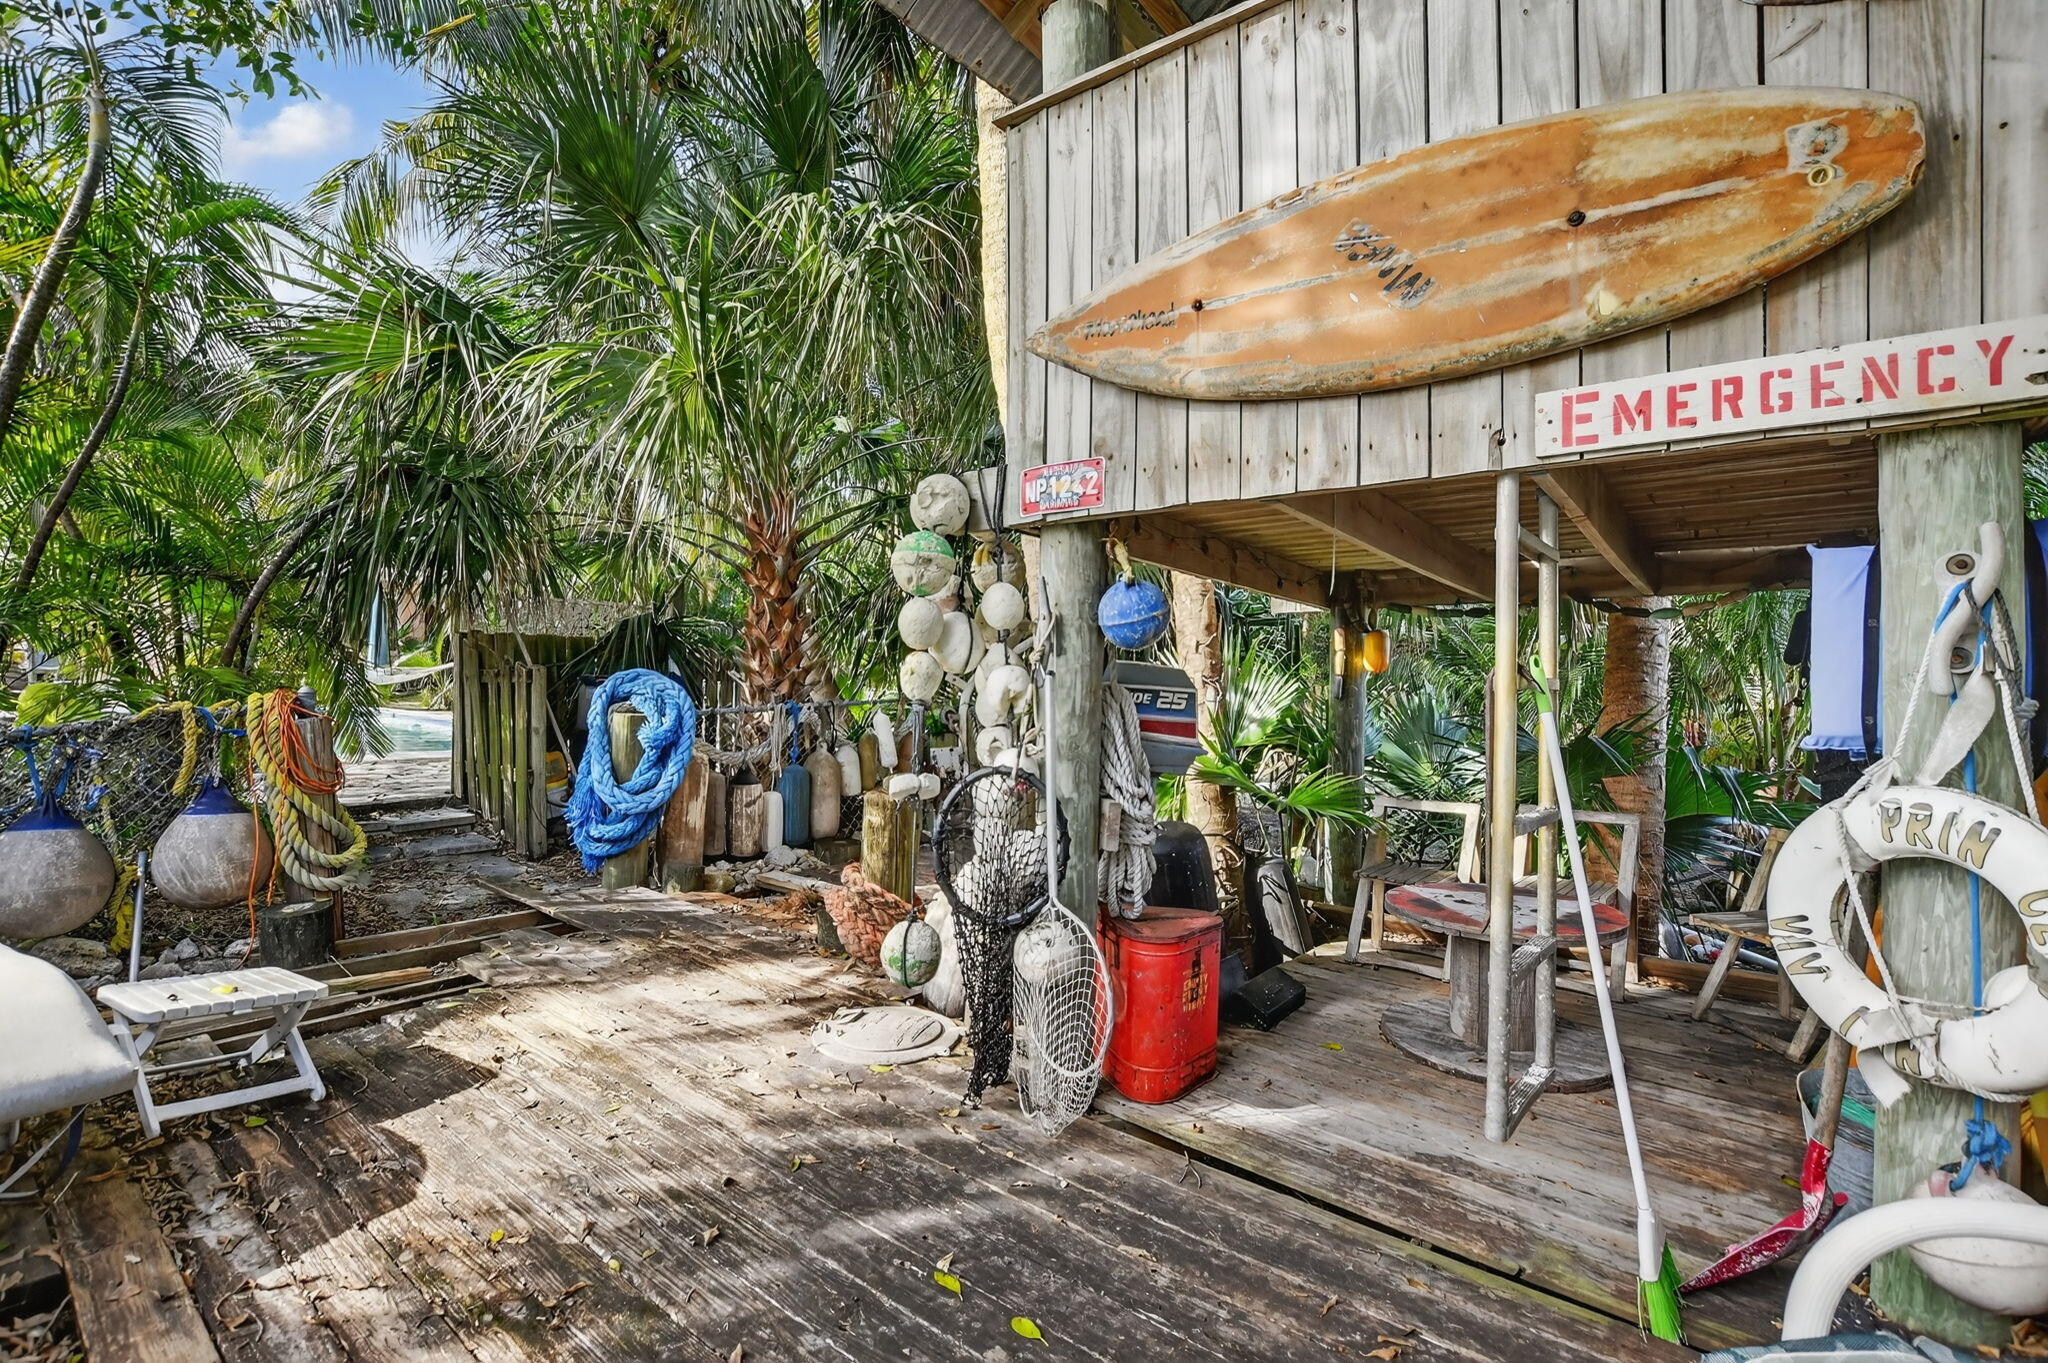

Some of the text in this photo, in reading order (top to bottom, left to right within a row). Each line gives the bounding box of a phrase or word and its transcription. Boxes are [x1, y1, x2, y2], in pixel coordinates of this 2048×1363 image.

[1561, 334, 2015, 448] EMERGENCY
[1156, 690, 1189, 710] 25
[1877, 798, 2002, 870] PRIN
